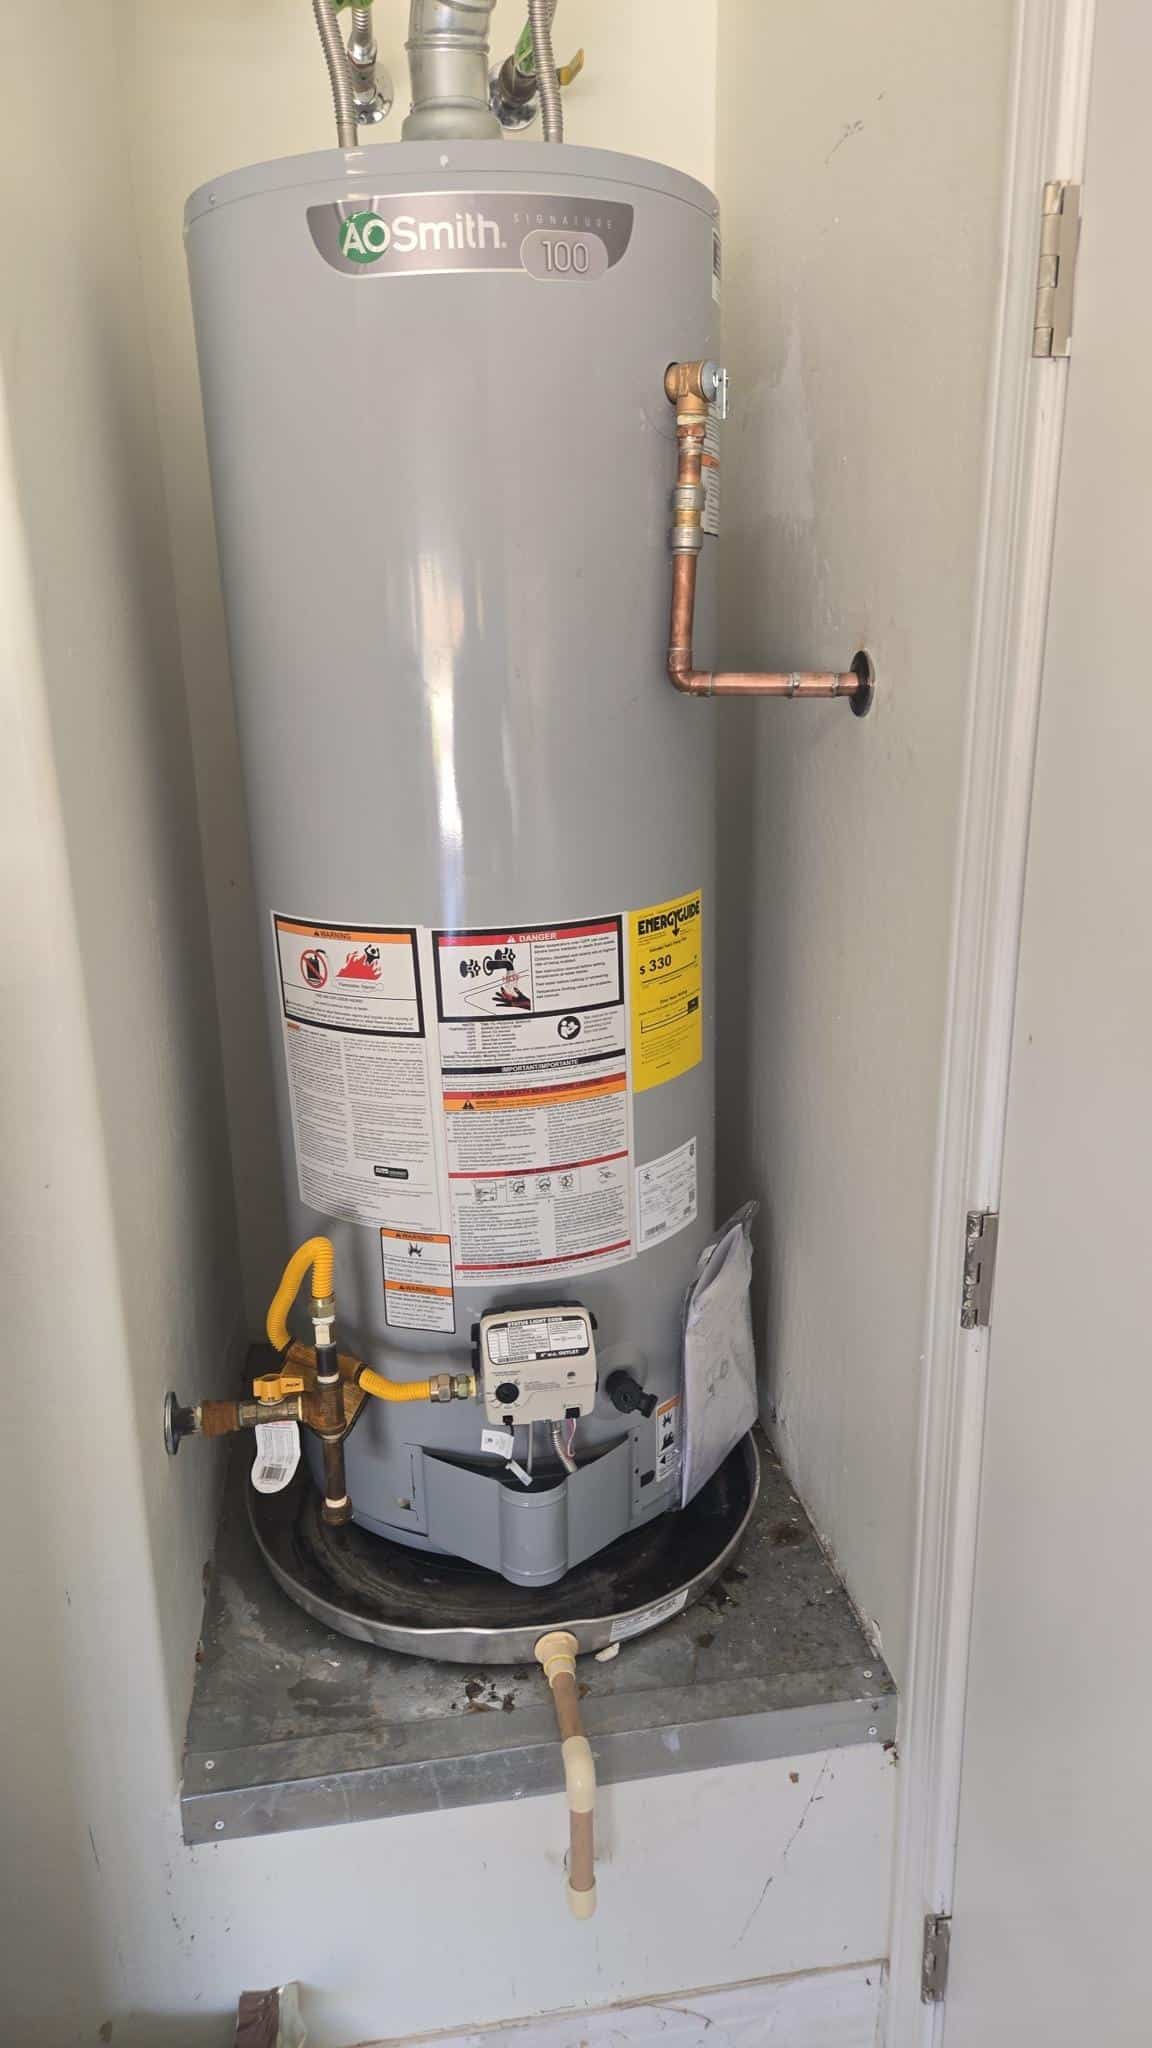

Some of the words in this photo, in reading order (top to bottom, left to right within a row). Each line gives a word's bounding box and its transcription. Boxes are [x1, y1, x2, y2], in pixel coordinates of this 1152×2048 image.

[513, 213, 613, 229] SIGNATURE
[543, 241, 589, 272] 100
[638, 901, 700, 936] ENERGYGUIDE
[519, 932, 557, 943] DANGER
[649, 954, 672, 972] 330
